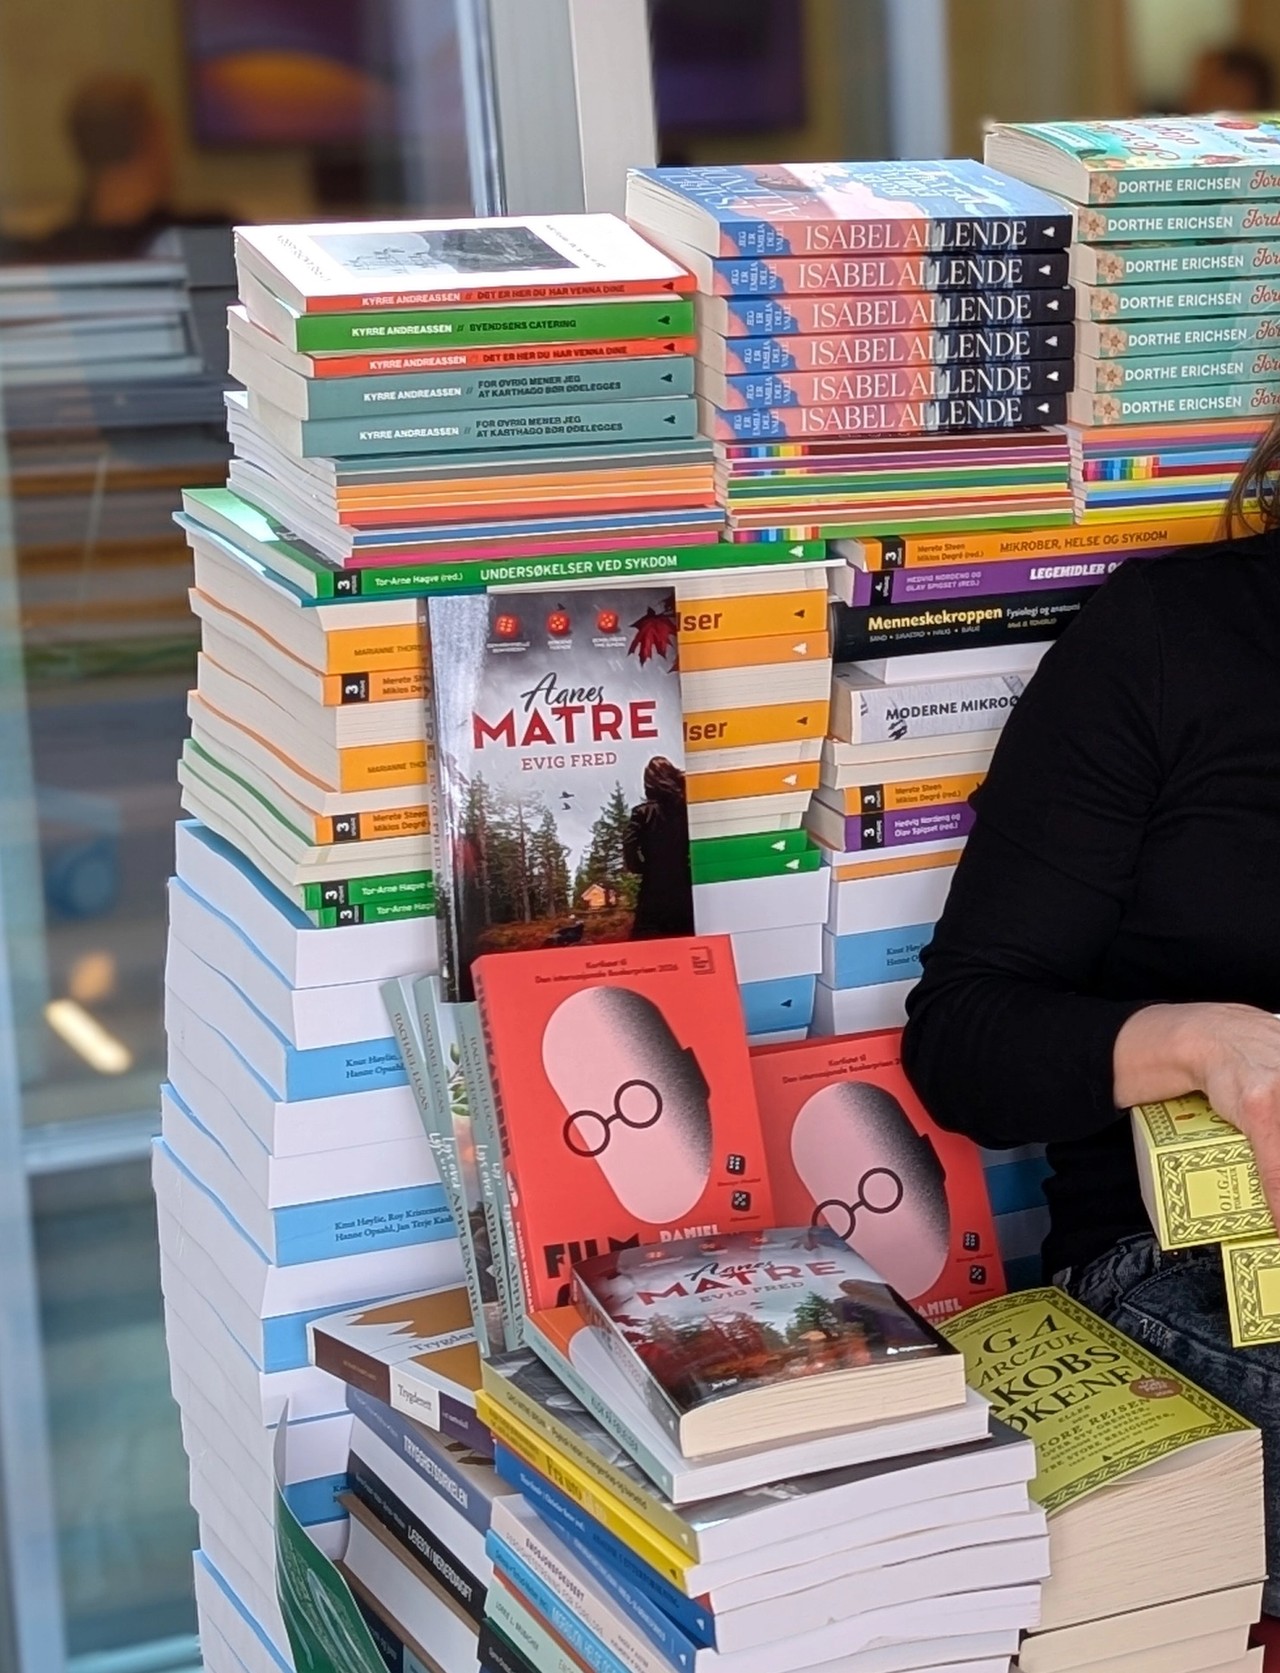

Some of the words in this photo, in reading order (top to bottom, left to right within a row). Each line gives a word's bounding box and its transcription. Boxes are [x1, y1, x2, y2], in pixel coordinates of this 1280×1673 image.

[1119, 181, 1172, 194] DORTHE
[1177, 178, 1241, 191] ERICHSEN
[1108, 218, 1163, 231] DORTHE
[1168, 216, 1233, 229] ERICHSEN
[806, 224, 899, 250] ISABEL
[903, 221, 1028, 247] ALLENDE
[799, 262, 894, 288] ISABEL
[898, 259, 1023, 286] ALLENDE
[1126, 258, 1178, 273] DORTHE
[1182, 256, 1244, 270] ERICHSEN
[362, 296, 393, 306] KYRRE
[397, 293, 460, 304] ANDREASSEN
[477, 291, 495, 300] DET
[499, 290, 510, 298] ER
[533, 289, 546, 297] DU
[1120, 296, 1174, 309] DORTHE
[1178, 293, 1241, 307] ERICHSEN
[813, 301, 906, 328] ISABEL
[909, 295, 1032, 323] ALLENDE
[352, 327, 385, 337] KYRRE
[387, 324, 452, 335] ANDREASSEN
[470, 322, 527, 332] SVENDSENS
[529, 320, 576, 329] CATERING
[1129, 333, 1180, 347] DORTHE
[1185, 329, 1247, 344] ERICHSEN
[811, 337, 904, 366] ISABEL
[908, 331, 1030, 361] ALLENDE
[370, 360, 401, 369] KYRRE
[403, 356, 466, 367] ANDREASSEN
[483, 353, 501, 362] DET
[503, 353, 515, 361] ER
[537, 351, 550, 359] DU
[1125, 368, 1178, 381] DORTHE
[1181, 363, 1243, 377] ERICHSEN
[479, 380, 496, 389] FOR
[564, 375, 580, 384] JEG
[813, 373, 906, 401] ISABEL
[909, 366, 1031, 395] ALLENDE
[364, 392, 396, 401] KYRRE
[398, 388, 461, 399] ANDREASSEN
[478, 390, 489, 398] AT
[492, 388, 543, 397] KARTHAGO
[801, 404, 895, 432] ISABEL
[898, 398, 1022, 427] ALLENDE
[1122, 401, 1174, 414] DORTHE
[1178, 397, 1241, 412] ERICHSEN
[360, 431, 392, 440] KYRRE
[394, 427, 459, 439] ANDREASSEN
[476, 420, 495, 428] FOR
[476, 430, 488, 438] AT
[1000, 538, 1061, 552] MIKROBER,
[1065, 535, 1100, 547] HELSE
[1103, 534, 1119, 544] OG
[1122, 531, 1167, 543] SYKDOM
[480, 563, 592, 580] UNDERSØKELSER
[596, 559, 621, 572] VED
[624, 556, 677, 571] SYKDOM
[1030, 564, 1104, 580] LEGEMIDLER
[338, 580, 350, 590] 3
[868, 608, 1002, 631] Menneskekroppen
[521, 672, 604, 721] Agnes
[886, 702, 957, 721] MODERNE
[961, 695, 1020, 712] MIKROØ
[472, 701, 658, 749] MATRE
[522, 755, 564, 770] EVIG
[572, 752, 617, 767] FRED
[1217, 1169, 1232, 1211] OLGA
[660, 1224, 721, 1243] DANIEL
[636, 1260, 845, 1307] MATRE
[701, 1291, 746, 1304] EVIG
[751, 1281, 804, 1295] FRED
[408, 1332, 474, 1350] Trygder
[982, 1314, 1066, 1354] GA
[974, 1332, 1088, 1390] ARCZUK
[990, 1345, 1121, 1414] KOBS
[1001, 1365, 1134, 1434] ØKENE
[1038, 1425, 1083, 1452] TORE
[1089, 1399, 1150, 1426] REISEN
